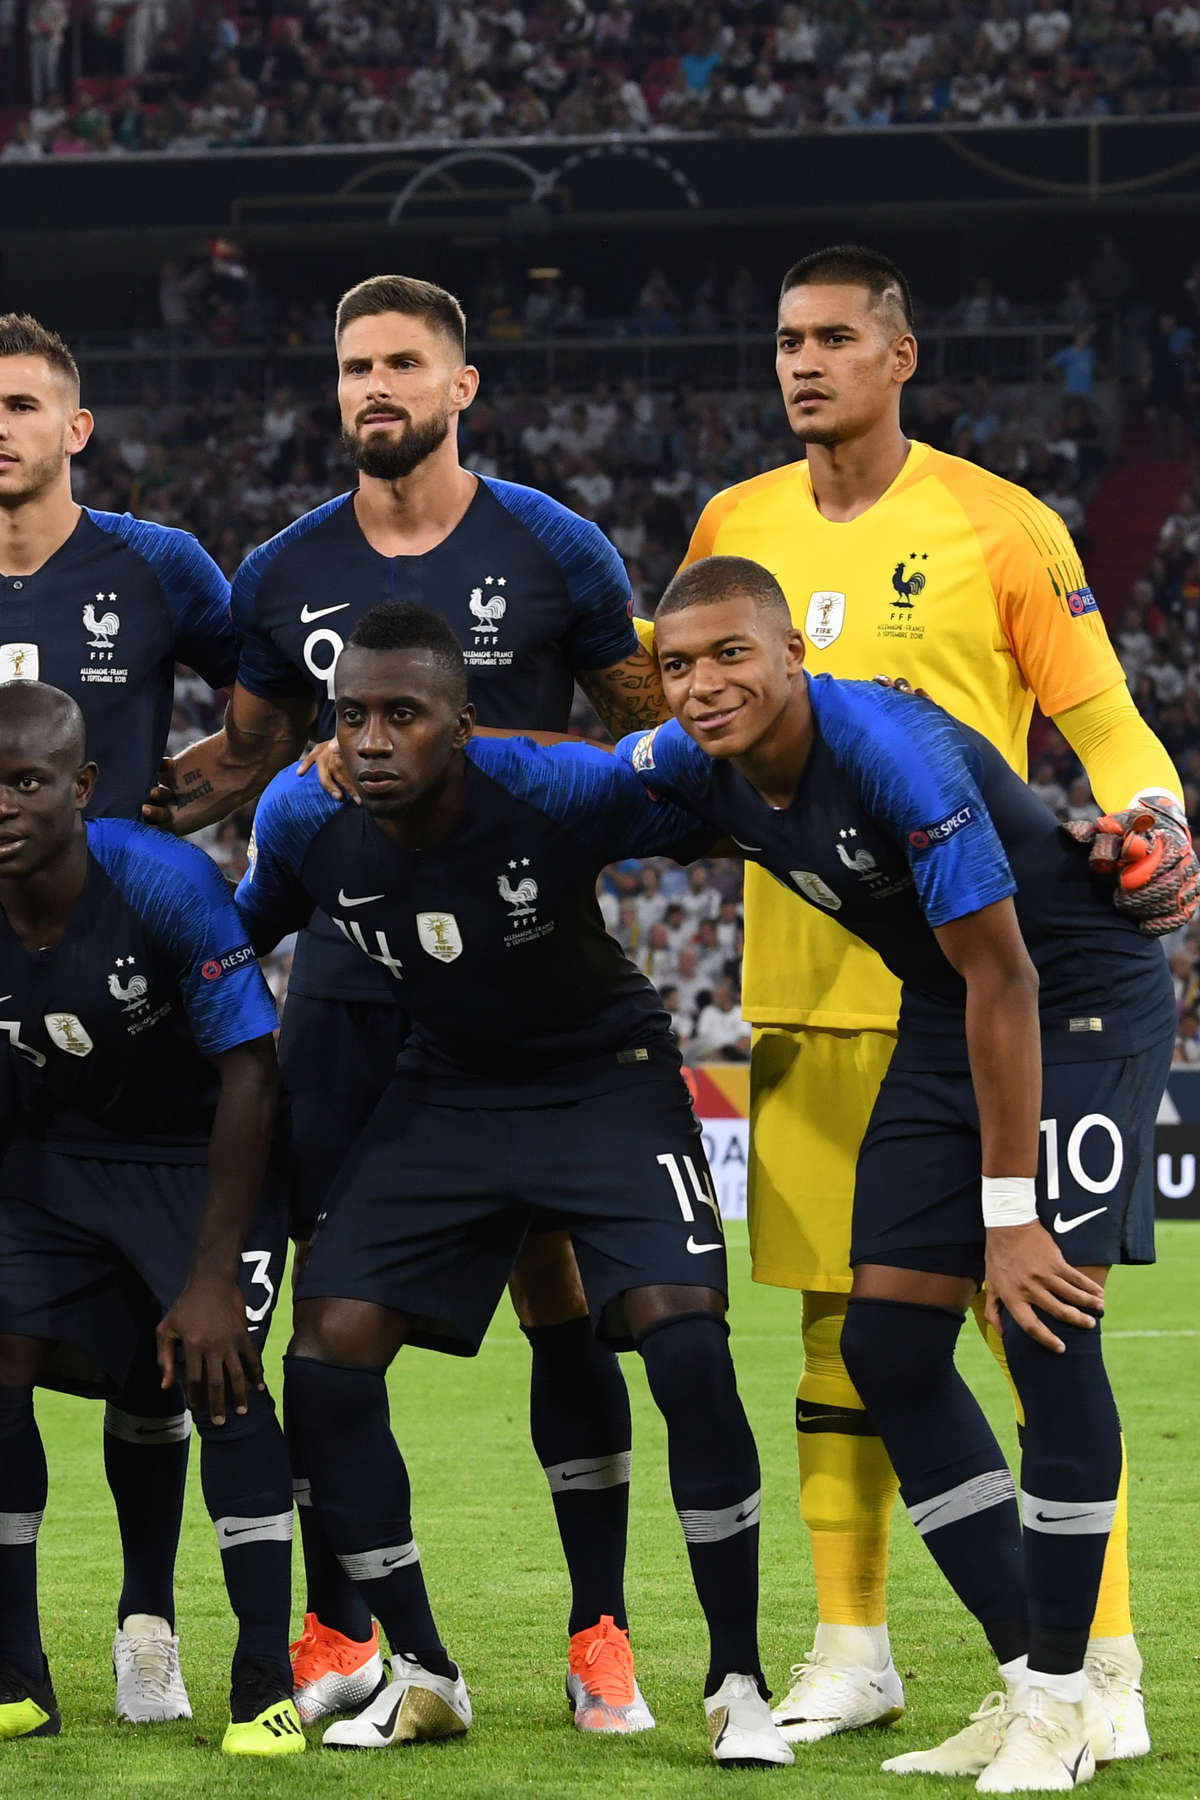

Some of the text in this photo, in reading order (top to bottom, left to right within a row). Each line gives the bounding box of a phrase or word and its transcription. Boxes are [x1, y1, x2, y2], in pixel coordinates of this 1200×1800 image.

[304, 628, 344, 700] 9
[926, 807, 971, 840] RESPECT
[1039, 1113, 1123, 1200] 10
[656, 1153, 722, 1233] 14
[240, 1250, 274, 1322] 3
